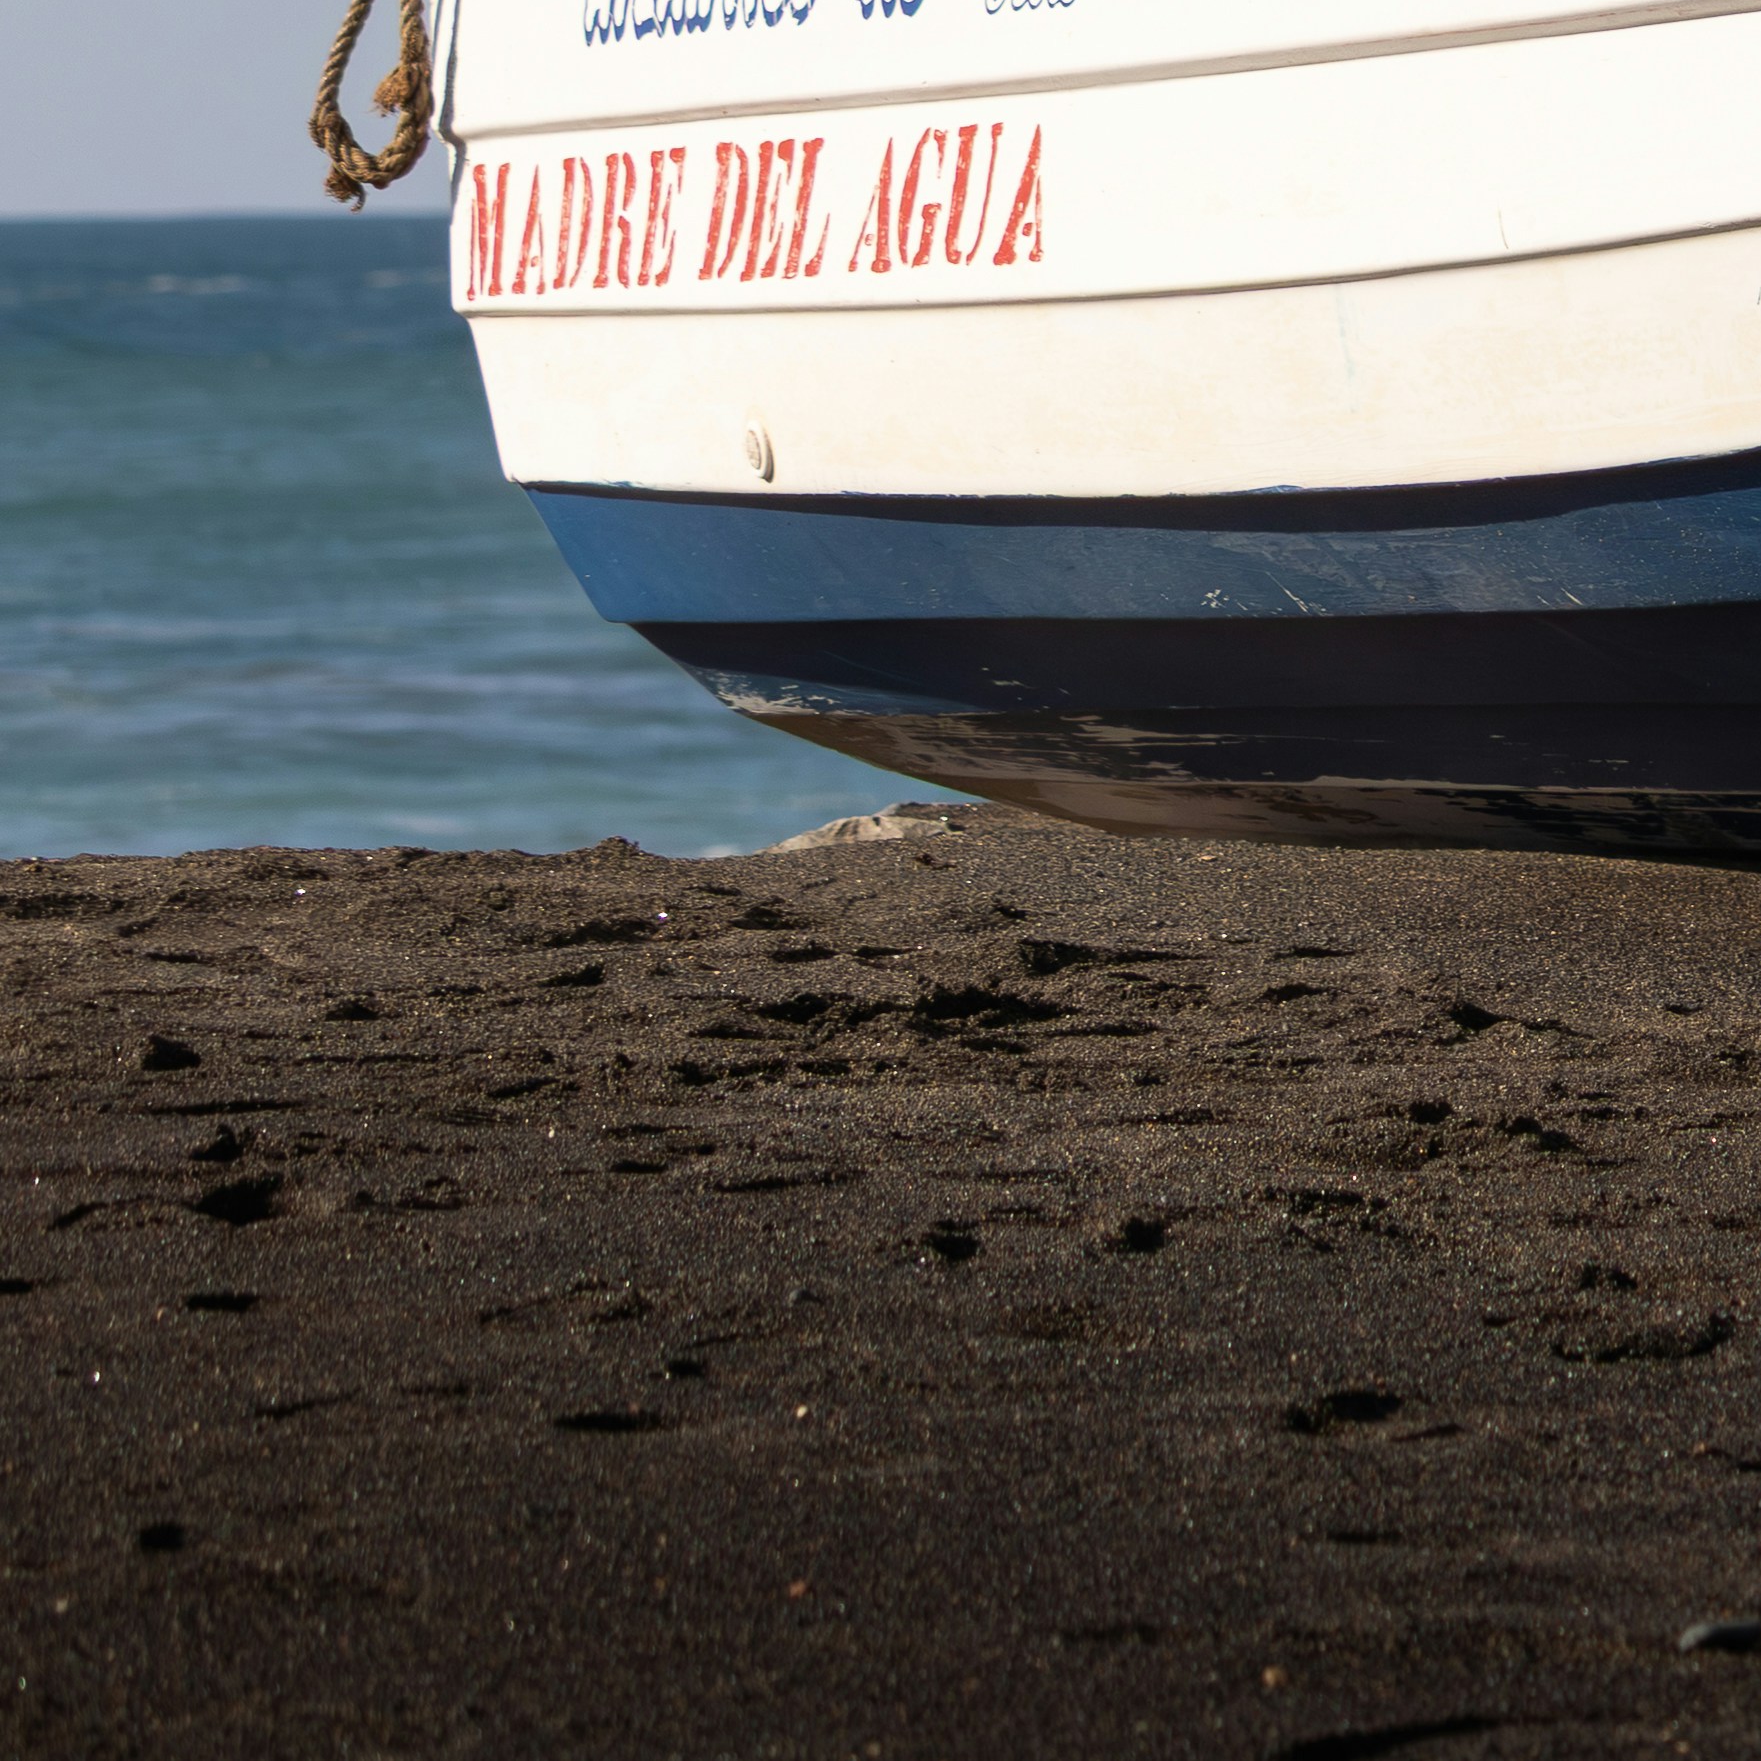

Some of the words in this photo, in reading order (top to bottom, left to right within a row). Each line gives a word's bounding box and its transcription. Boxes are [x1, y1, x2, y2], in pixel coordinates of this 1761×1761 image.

[466, 146, 686, 301] MADRE
[698, 138, 830, 282] DEL
[848, 122, 1043, 273] AGUA
